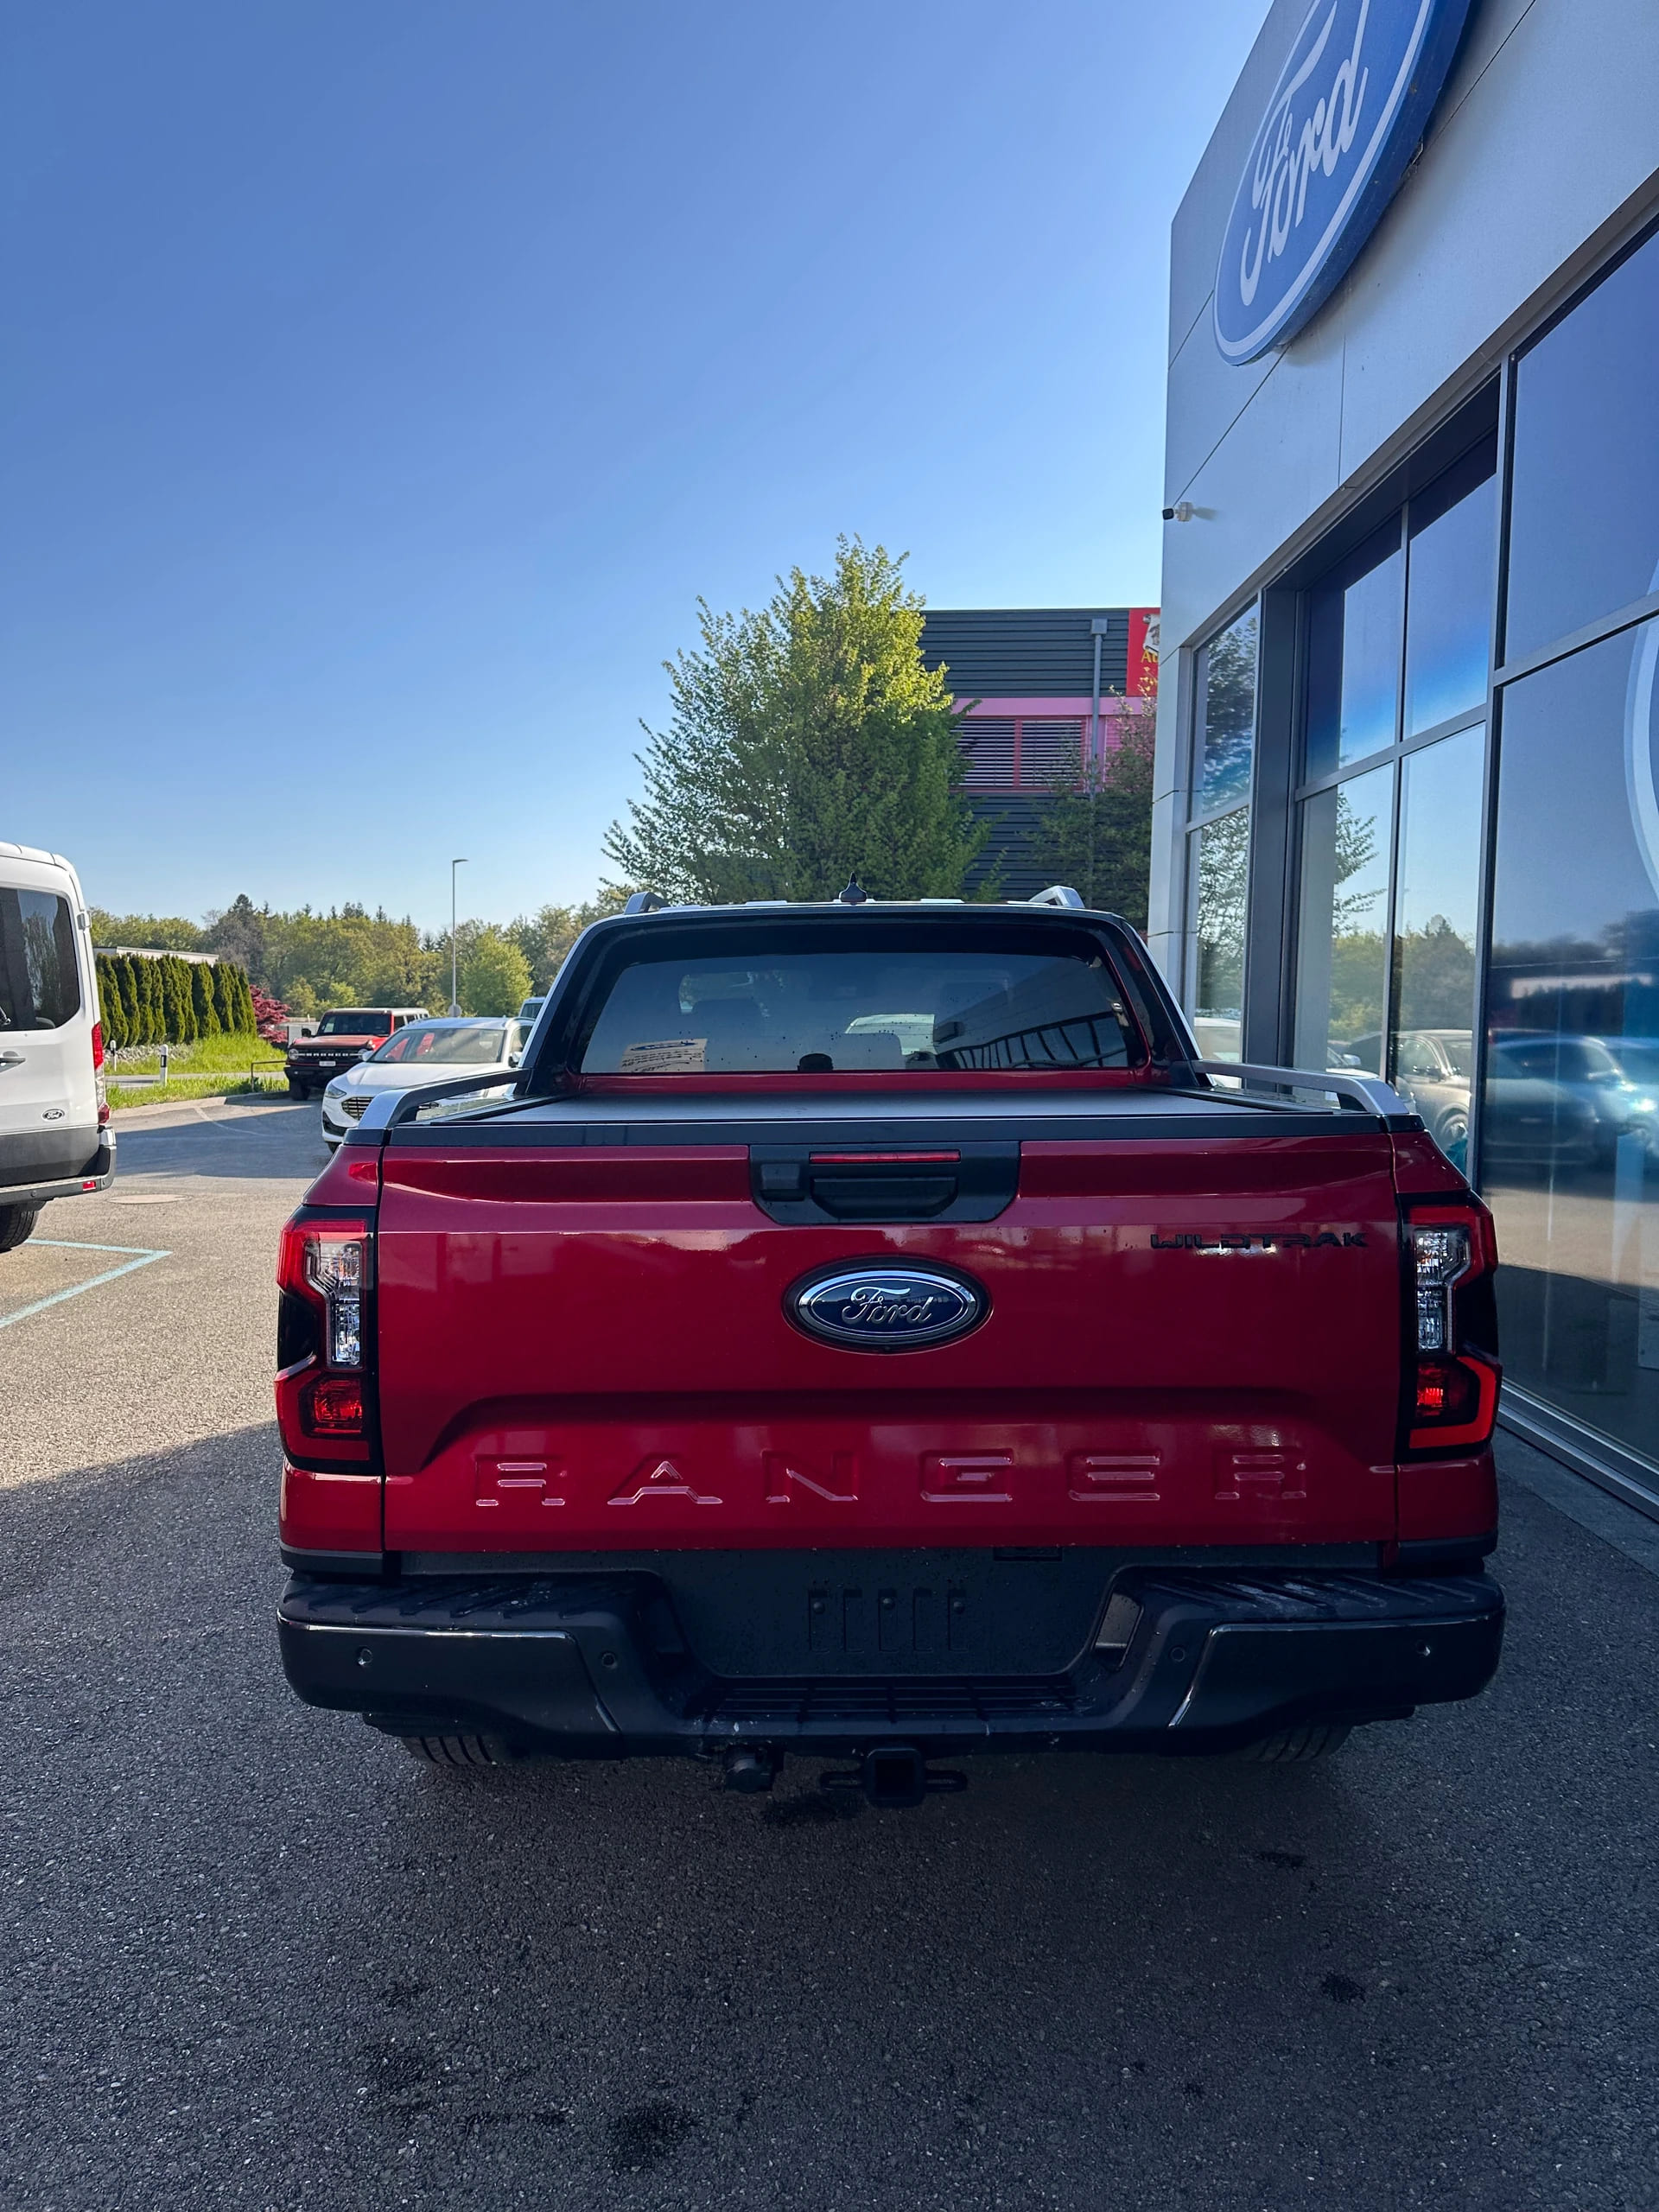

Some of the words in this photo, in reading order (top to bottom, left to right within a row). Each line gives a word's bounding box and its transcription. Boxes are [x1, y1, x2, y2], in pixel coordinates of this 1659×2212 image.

[1240, 0, 1369, 307] Ford
[1150, 1233, 1368, 1249] WILDTRAK
[842, 1286, 935, 1325] Ford
[474, 1448, 1307, 1506] RANGER
